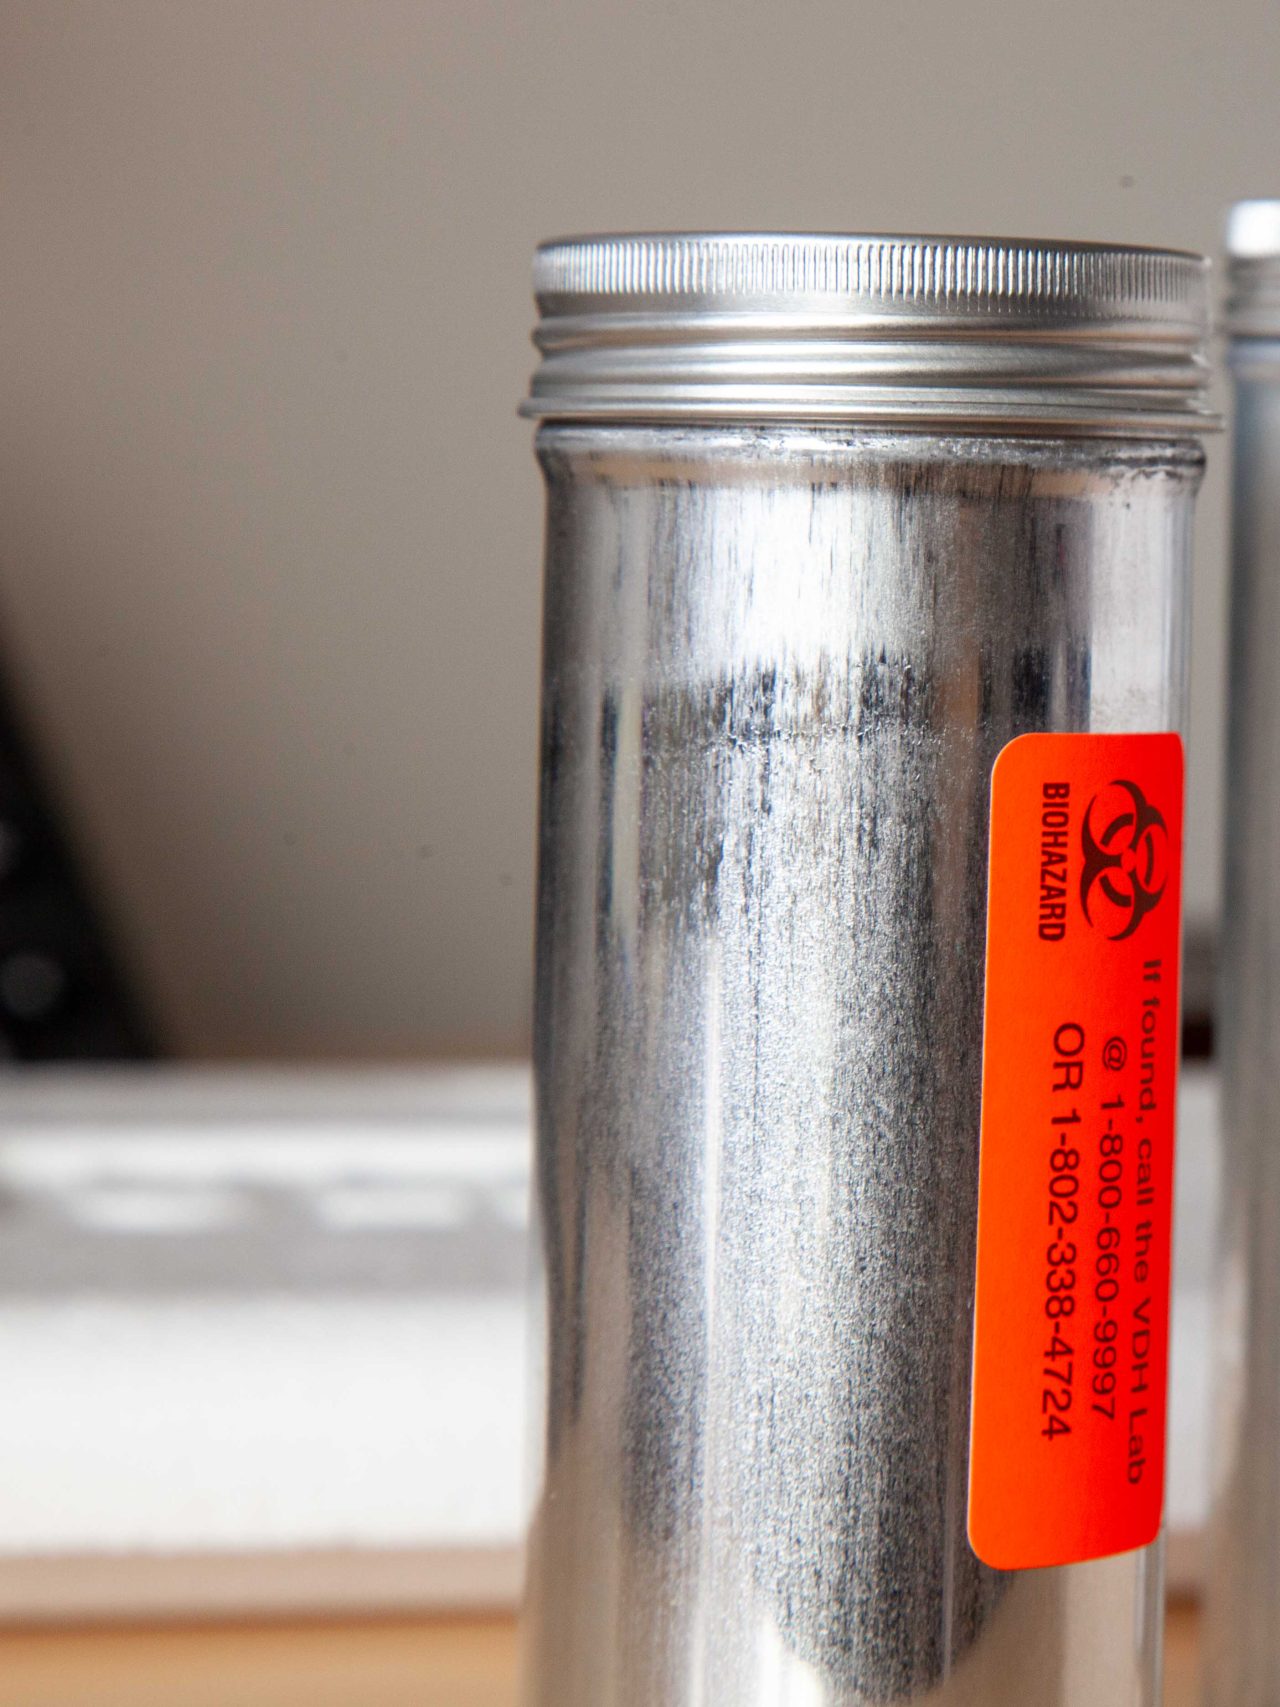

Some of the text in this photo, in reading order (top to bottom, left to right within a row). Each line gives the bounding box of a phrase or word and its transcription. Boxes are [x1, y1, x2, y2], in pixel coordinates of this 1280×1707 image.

[1038, 782, 1070, 942] BIOHAZARD
[1041, 1022, 1085, 1441] OR 1-802-338-4724
[1092, 1036, 1128, 1421] @ 1-800-660-9997
[1127, 959, 1162, 1485] If found, call the VDH Lab
